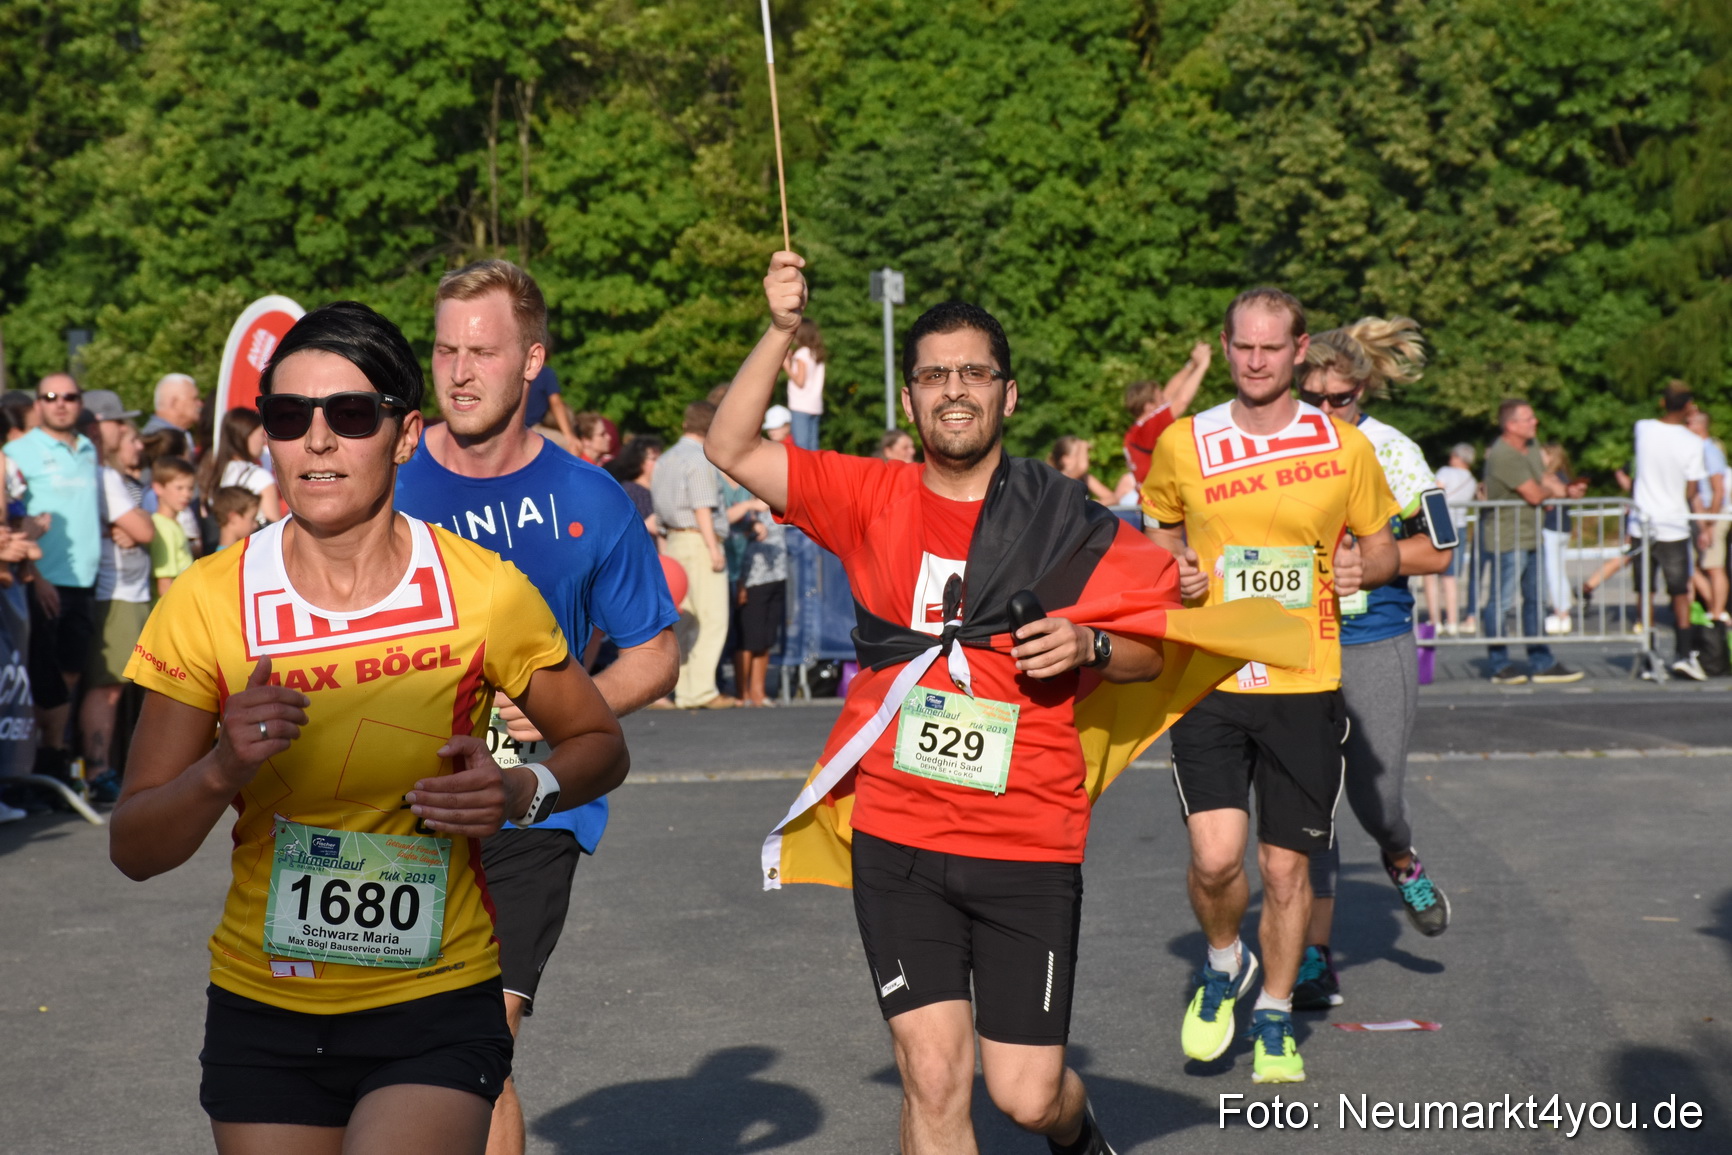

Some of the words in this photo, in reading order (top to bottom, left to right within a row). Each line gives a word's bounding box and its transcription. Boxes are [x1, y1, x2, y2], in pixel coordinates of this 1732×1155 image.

[1204, 473, 1267, 505] MAX
[1275, 460, 1346, 488] BÖGL
[1236, 569, 1301, 592] 1608
[355, 644, 462, 685] BÖGL
[986, 724, 1009, 735] 2019
[918, 721, 985, 762] 529
[498, 757, 528, 765] Tobias
[915, 752, 958, 768] Ouedghiri
[960, 761, 983, 773] Saad
[920, 762, 937, 771] DEHN
[297, 850, 366, 871] firmenlauf
[404, 872, 436, 884] 2019
[290, 874, 421, 931] 1680
[302, 924, 359, 942] Schwarz
[362, 932, 400, 945] Maria
[288, 935, 305, 946] Max
[307, 938, 328, 951] Bögl
[330, 941, 381, 954] Bauservice
[384, 945, 412, 956] GmbH
